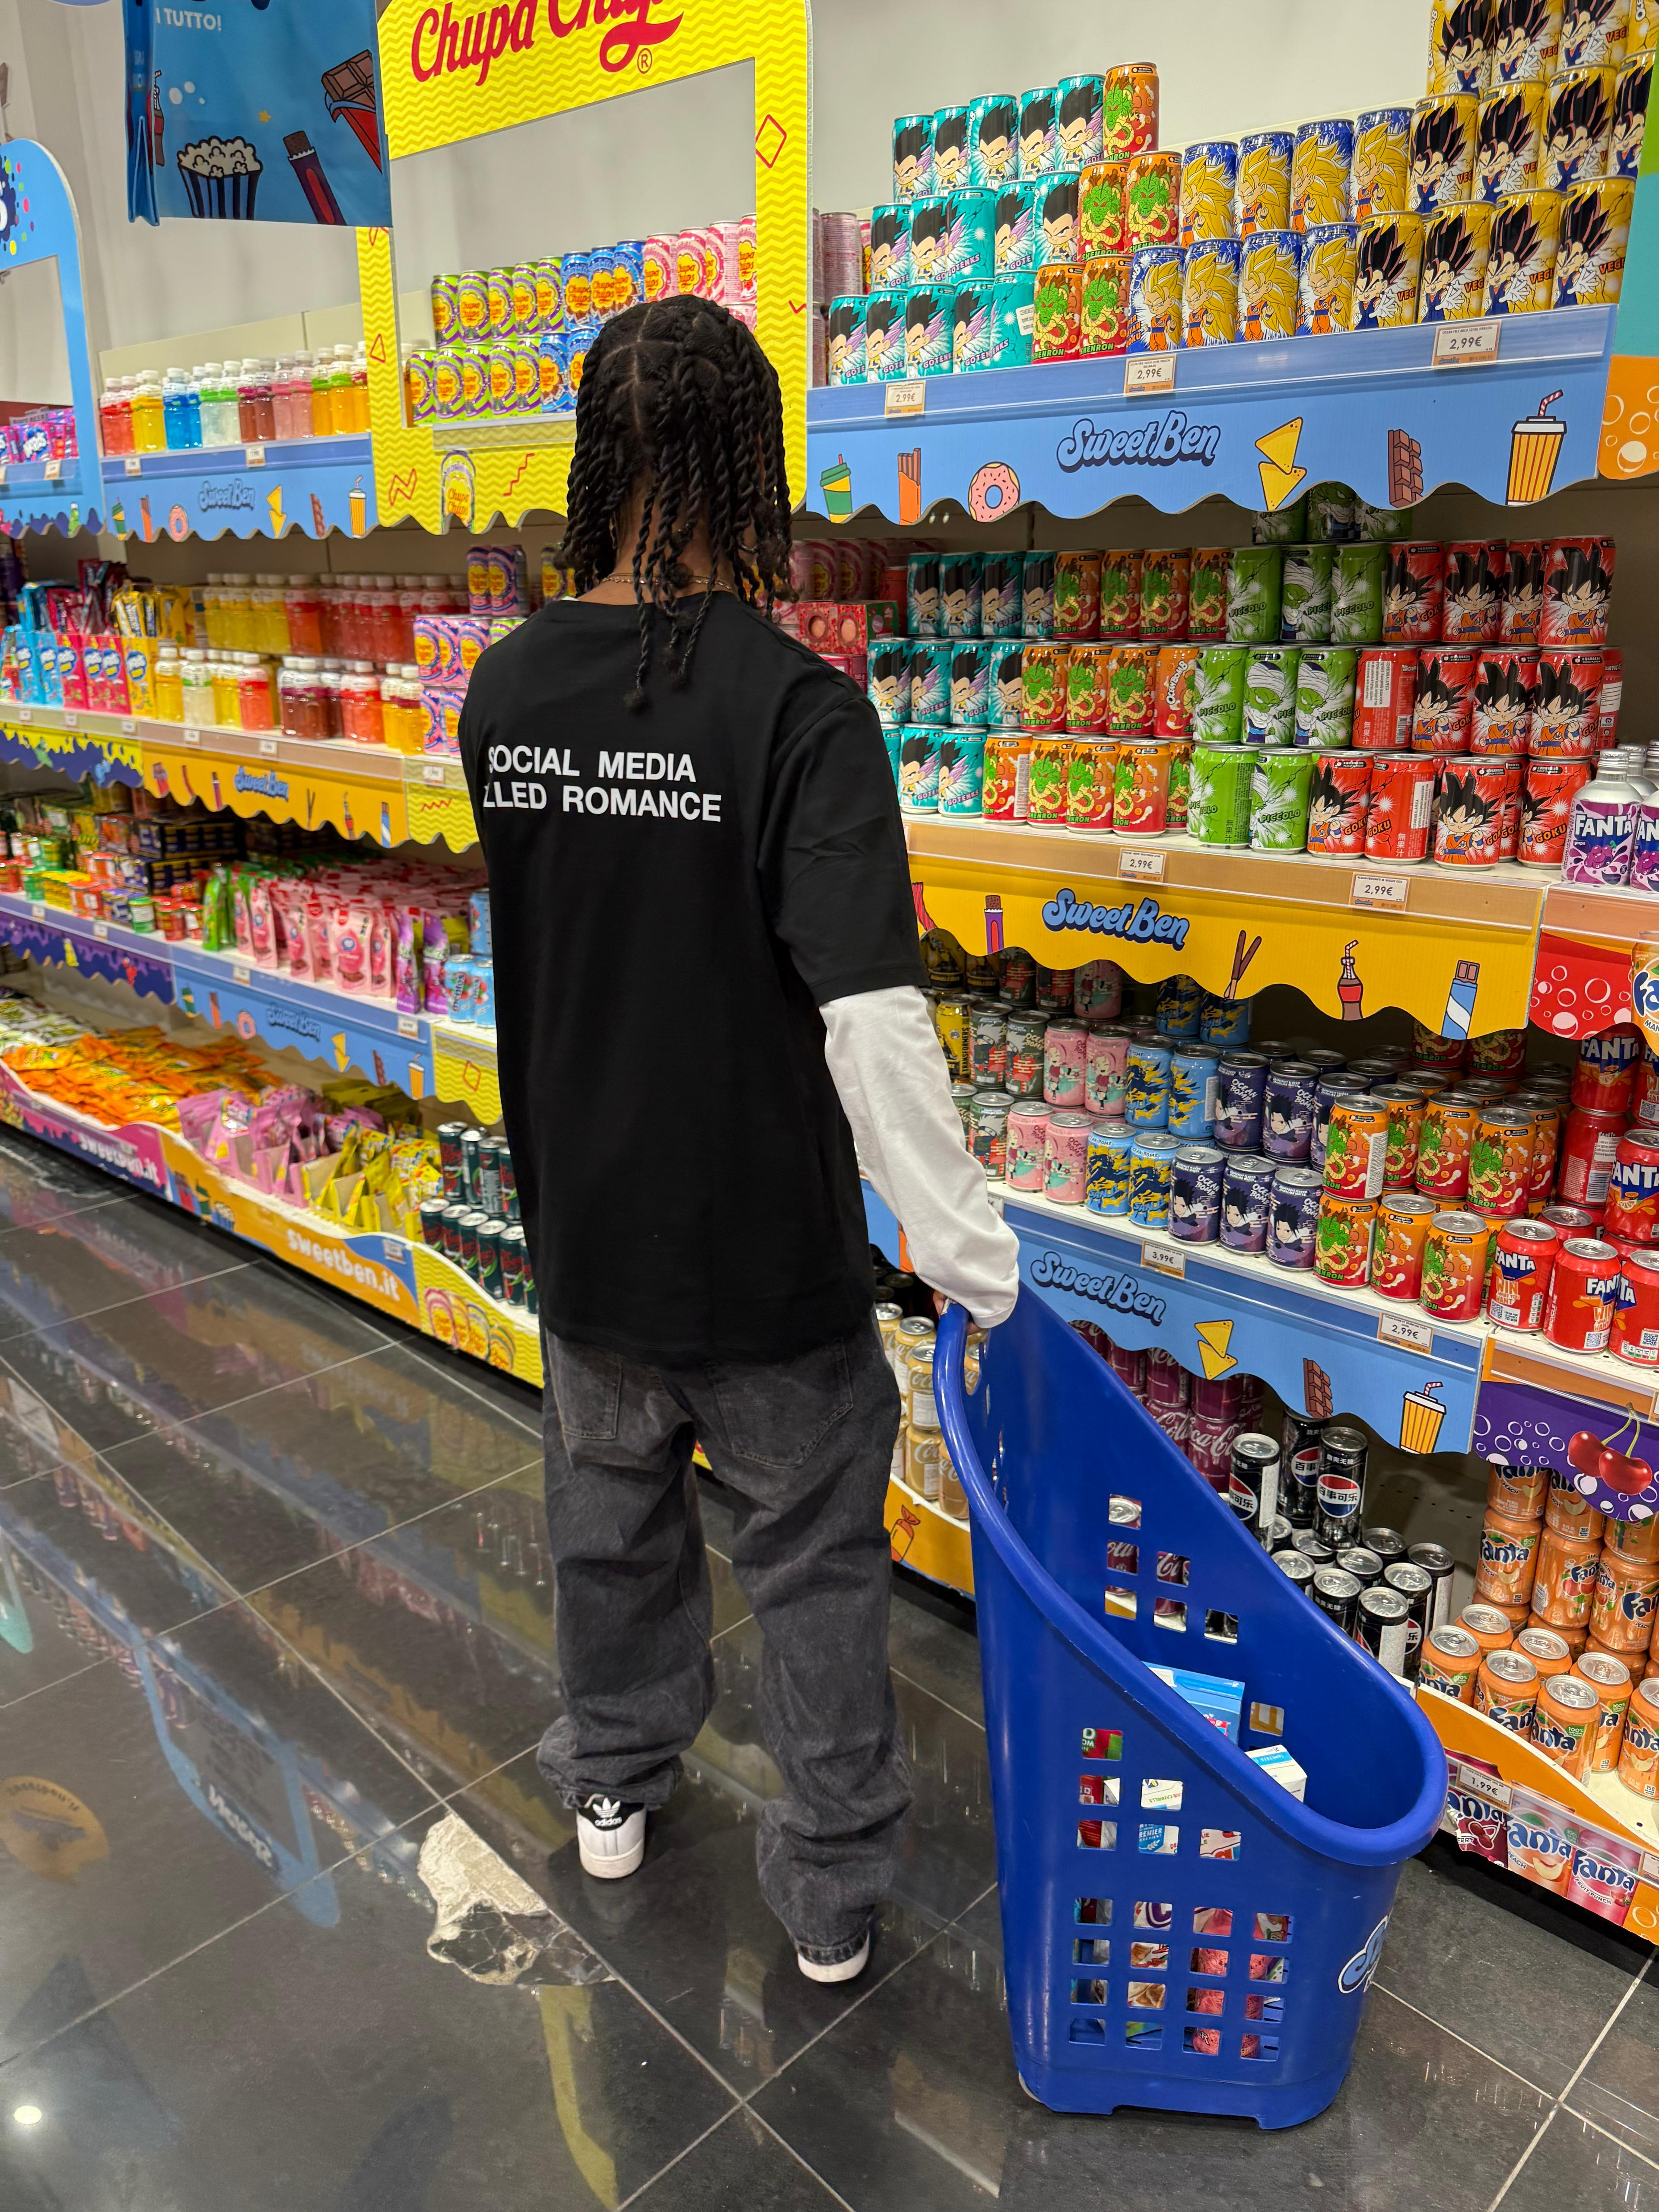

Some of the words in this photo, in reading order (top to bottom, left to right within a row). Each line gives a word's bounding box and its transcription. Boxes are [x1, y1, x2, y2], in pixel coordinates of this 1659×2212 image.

[163, 9, 222, 32] TUTTO!
[1606, 26, 1627, 42] VEG
[412, 0, 535, 86] Chupa
[1540, 44, 1558, 59] VEG
[1457, 171, 1473, 184] VEG
[1010, 254, 1032, 270] GOTE
[1599, 260, 1624, 275] VEGI
[890, 274, 909, 288] GOTE
[1529, 268, 1554, 284] VEGI
[1397, 287, 1417, 302] VEGI
[1449, 336, 1482, 350] 2,99€
[923, 353, 952, 369] GOTEN
[964, 349, 991, 366] GOTEN
[845, 366, 864, 378] GOTE
[883, 360, 904, 374] GOTE
[1137, 368, 1161, 380] 2,99€
[896, 393, 915, 403] 2,99€
[1336, 601, 1374, 617] PICCOLO
[969, 704, 988, 717] GOTE
[1199, 702, 1236, 717] PICCOLO
[1322, 705, 1352, 721] PICCOL
[488, 744, 580, 776] SOCIAL
[598, 751, 696, 783] MEDIA
[917, 787, 938, 801] GOTE
[947, 788, 979, 806] GOTENKS
[483, 782, 547, 810] LLED
[563, 785, 721, 823] ROMANCE
[1261, 809, 1301, 823] PICCOLO
[1368, 819, 1392, 837] GOKU
[1535, 823, 1568, 843] GOKU
[1575, 814, 1632, 837] FANTA
[1129, 859, 1153, 869] 2,99€
[1364, 884, 1393, 896] 2,99€
[1643, 1019, 1659, 1033] MAN
[1581, 1038, 1639, 1060] FANTA
[1230, 1084, 1252, 1101] BOMB
[1232, 1078, 1258, 1099] OCEAN
[1198, 1174, 1220, 1192] OCEAN
[1613, 1161, 1659, 1189] ANT
[1195, 1180, 1214, 1196] BOMB
[1152, 1252, 1174, 1264] 3,99€
[1495, 1246, 1536, 1271] FANTA
[1496, 1277, 1519, 1294] WIN
[1392, 1325, 1418, 1339] 2,99€
[1295, 1461, 1318, 1472] 百事
[1319, 1486, 1358, 1502] 百事可乐
[1472, 1777, 1498, 1796] 1,99€
[1447, 1791, 1504, 1822] anta
[1139, 1827, 1163, 1838] REMIER
[1507, 1851, 1527, 1870] PEACH
[1573, 1849, 1637, 1892] Fanta
[1574, 1877, 1589, 1894] FRUIT
[1589, 1891, 1612, 1905] PUNCH
